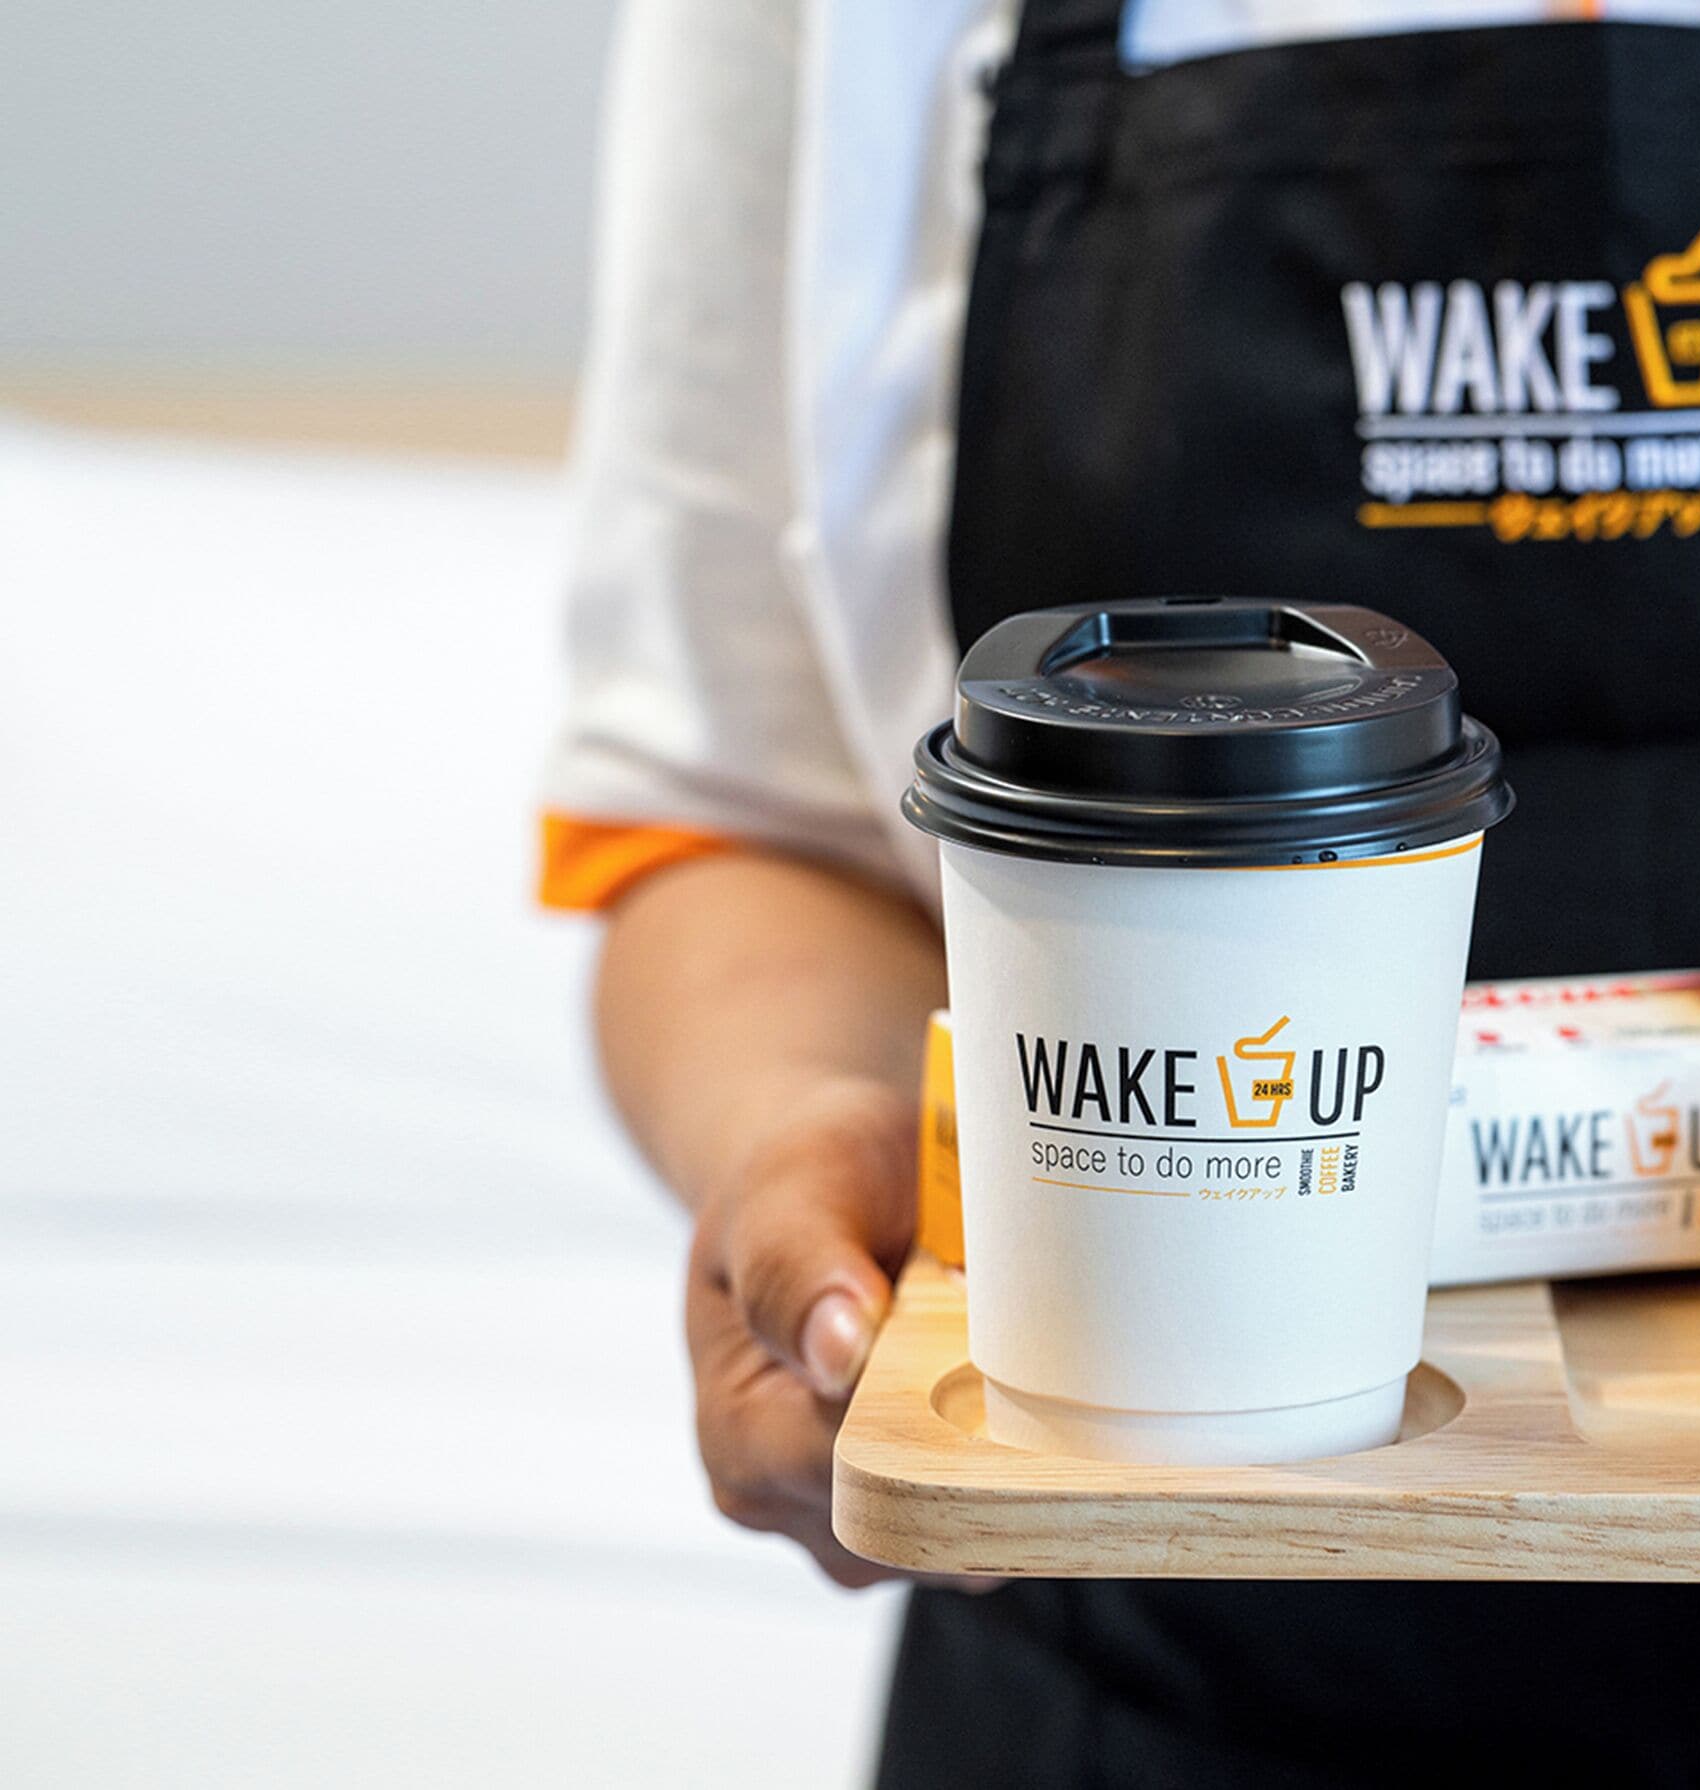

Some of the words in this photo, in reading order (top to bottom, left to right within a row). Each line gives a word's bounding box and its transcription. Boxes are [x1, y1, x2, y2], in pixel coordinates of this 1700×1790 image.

[1341, 278, 1620, 415] WAKE
[1015, 1032, 1198, 1128] WAKE
[1309, 1045, 1385, 1126] UP
[1254, 1082, 1269, 1097] 24
[1270, 1082, 1293, 1096] HRS
[1031, 1139, 1107, 1173] space
[1117, 1146, 1145, 1177] to
[1156, 1147, 1194, 1179] do
[1206, 1156, 1282, 1180] more
[1318, 1146, 1340, 1195] COFFEE
[1341, 1144, 1359, 1192] BAKERY
[1470, 1108, 1613, 1185] WAKE
[1199, 1186, 1287, 1201] ウェイクアップ
[1298, 1148, 1315, 1197] SMOOTHIE
